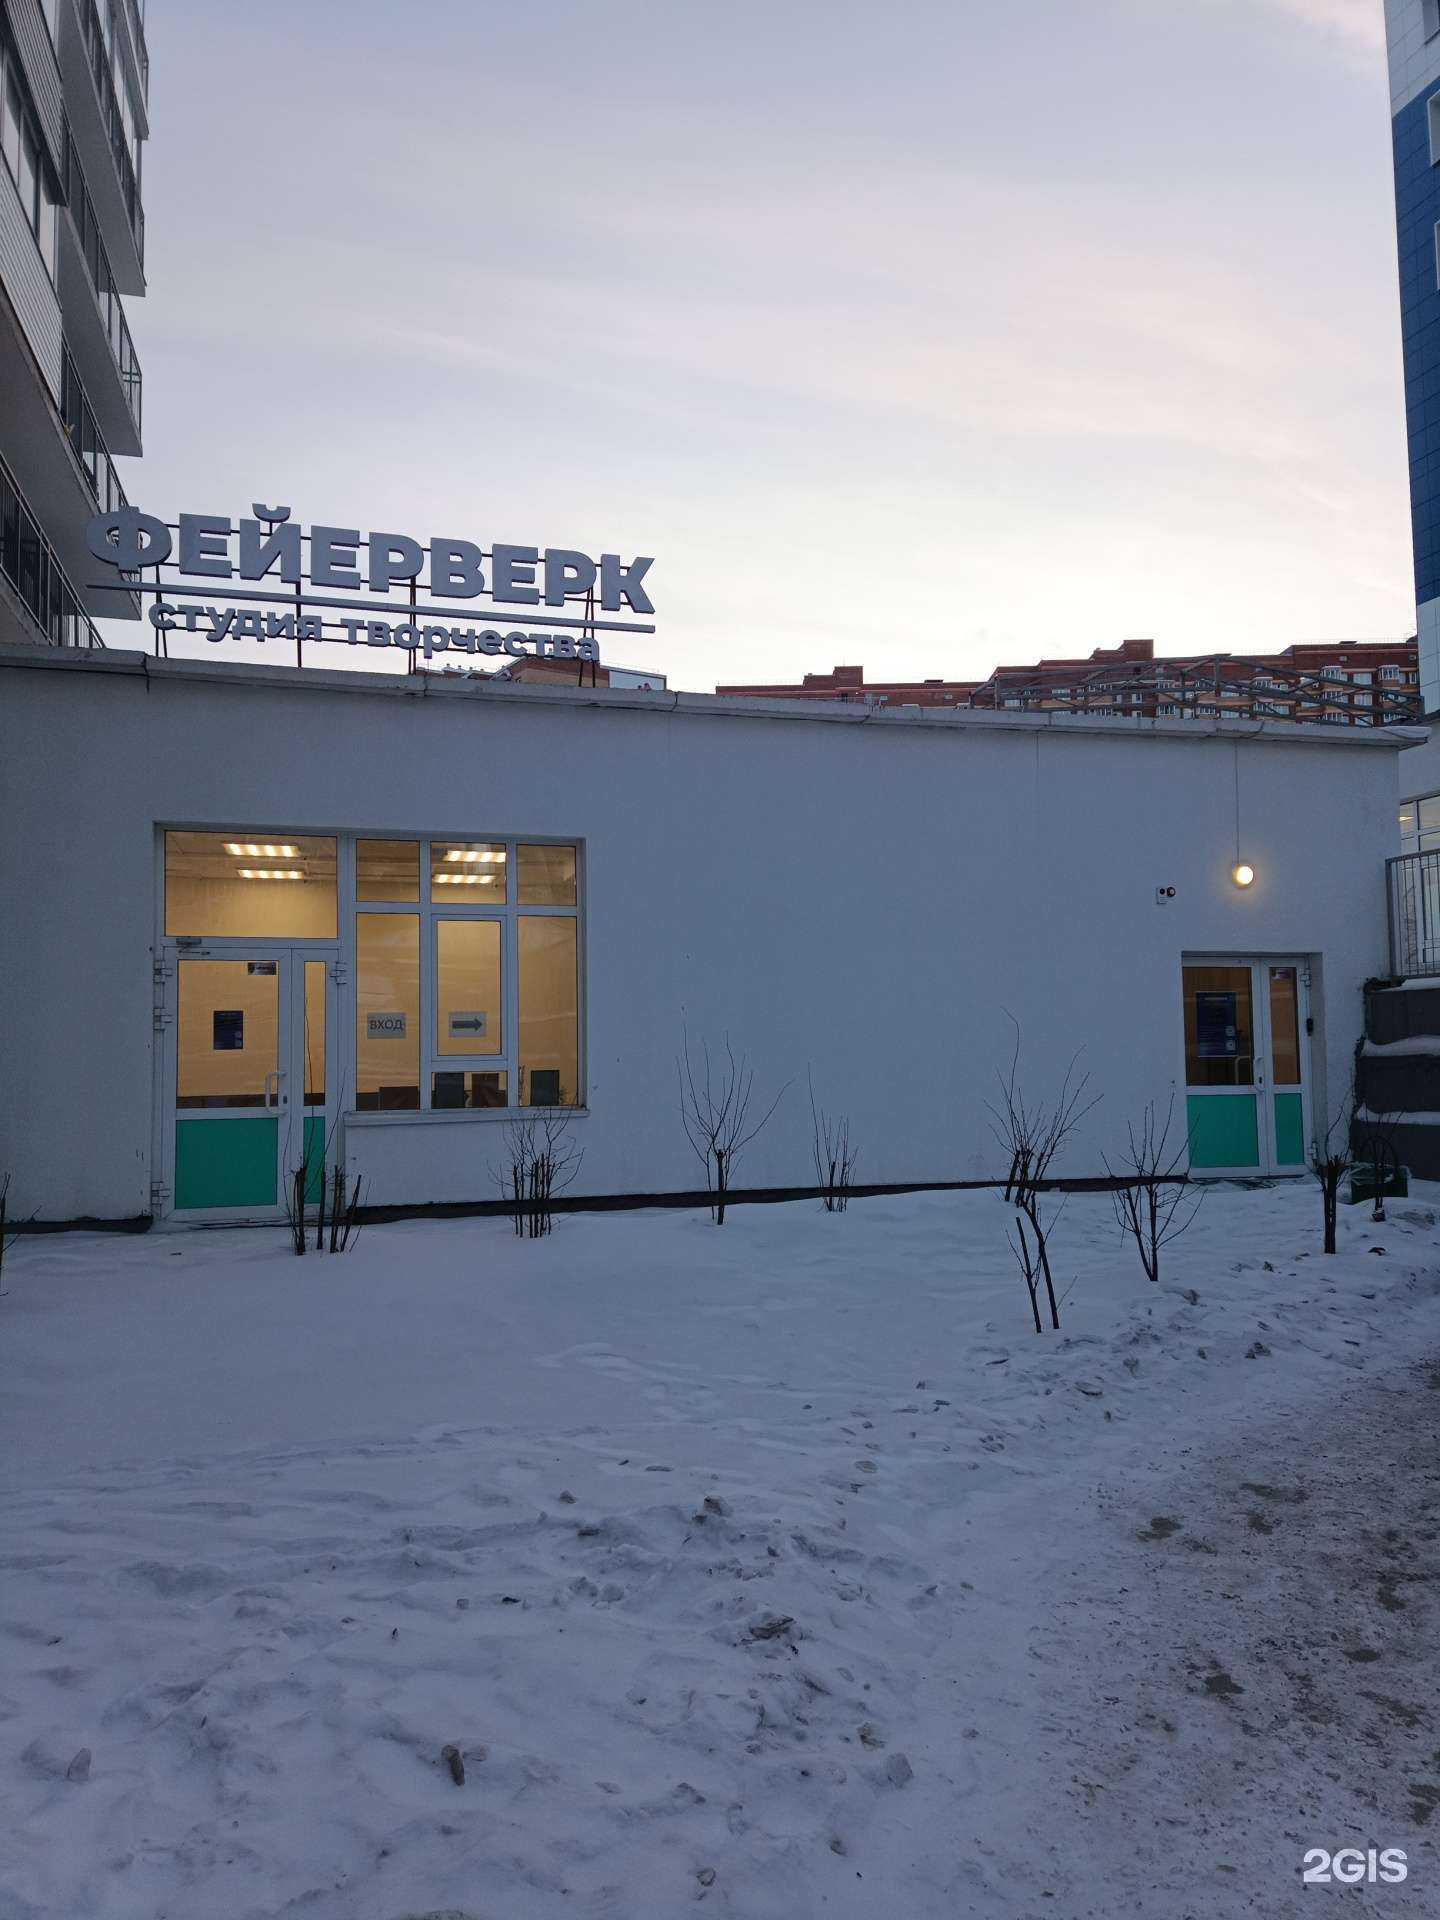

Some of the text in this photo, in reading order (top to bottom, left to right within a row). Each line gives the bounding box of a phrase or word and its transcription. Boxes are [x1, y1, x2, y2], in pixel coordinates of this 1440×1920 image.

[86, 502, 656, 614] ФЕЙЕРВЕРК
[148, 602, 600, 662] студия творчества
[369, 1019, 403, 1031] ВХОД
